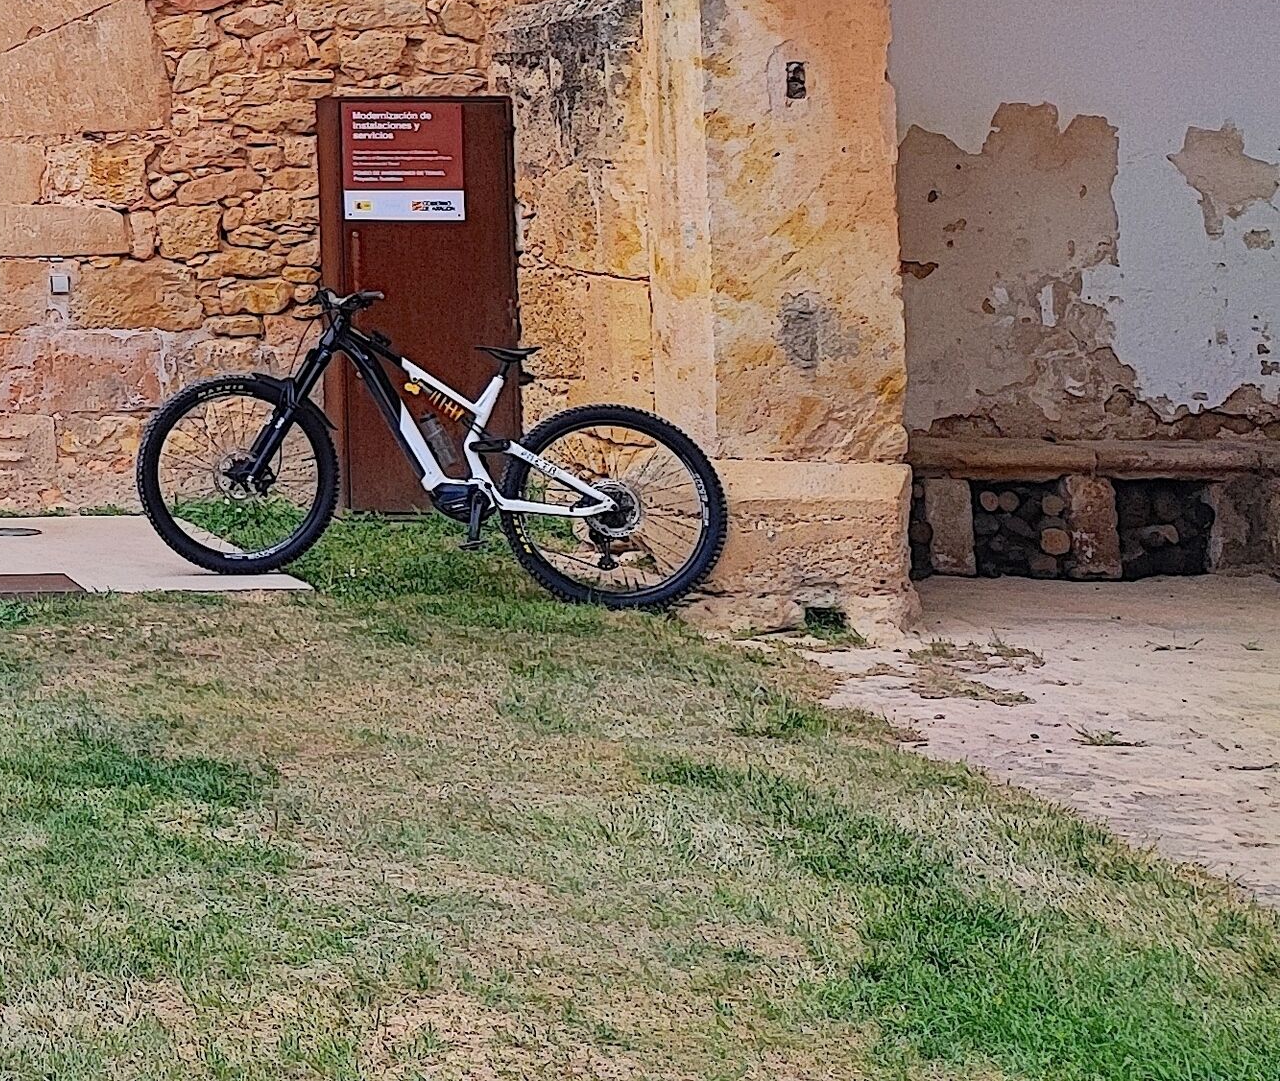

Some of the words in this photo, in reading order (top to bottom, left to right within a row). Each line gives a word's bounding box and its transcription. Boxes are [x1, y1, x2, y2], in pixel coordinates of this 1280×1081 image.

[352, 111, 418, 119] Modernización
[419, 111, 432, 119] de
[413, 123, 420, 131] y
[352, 132, 394, 140] servicios
